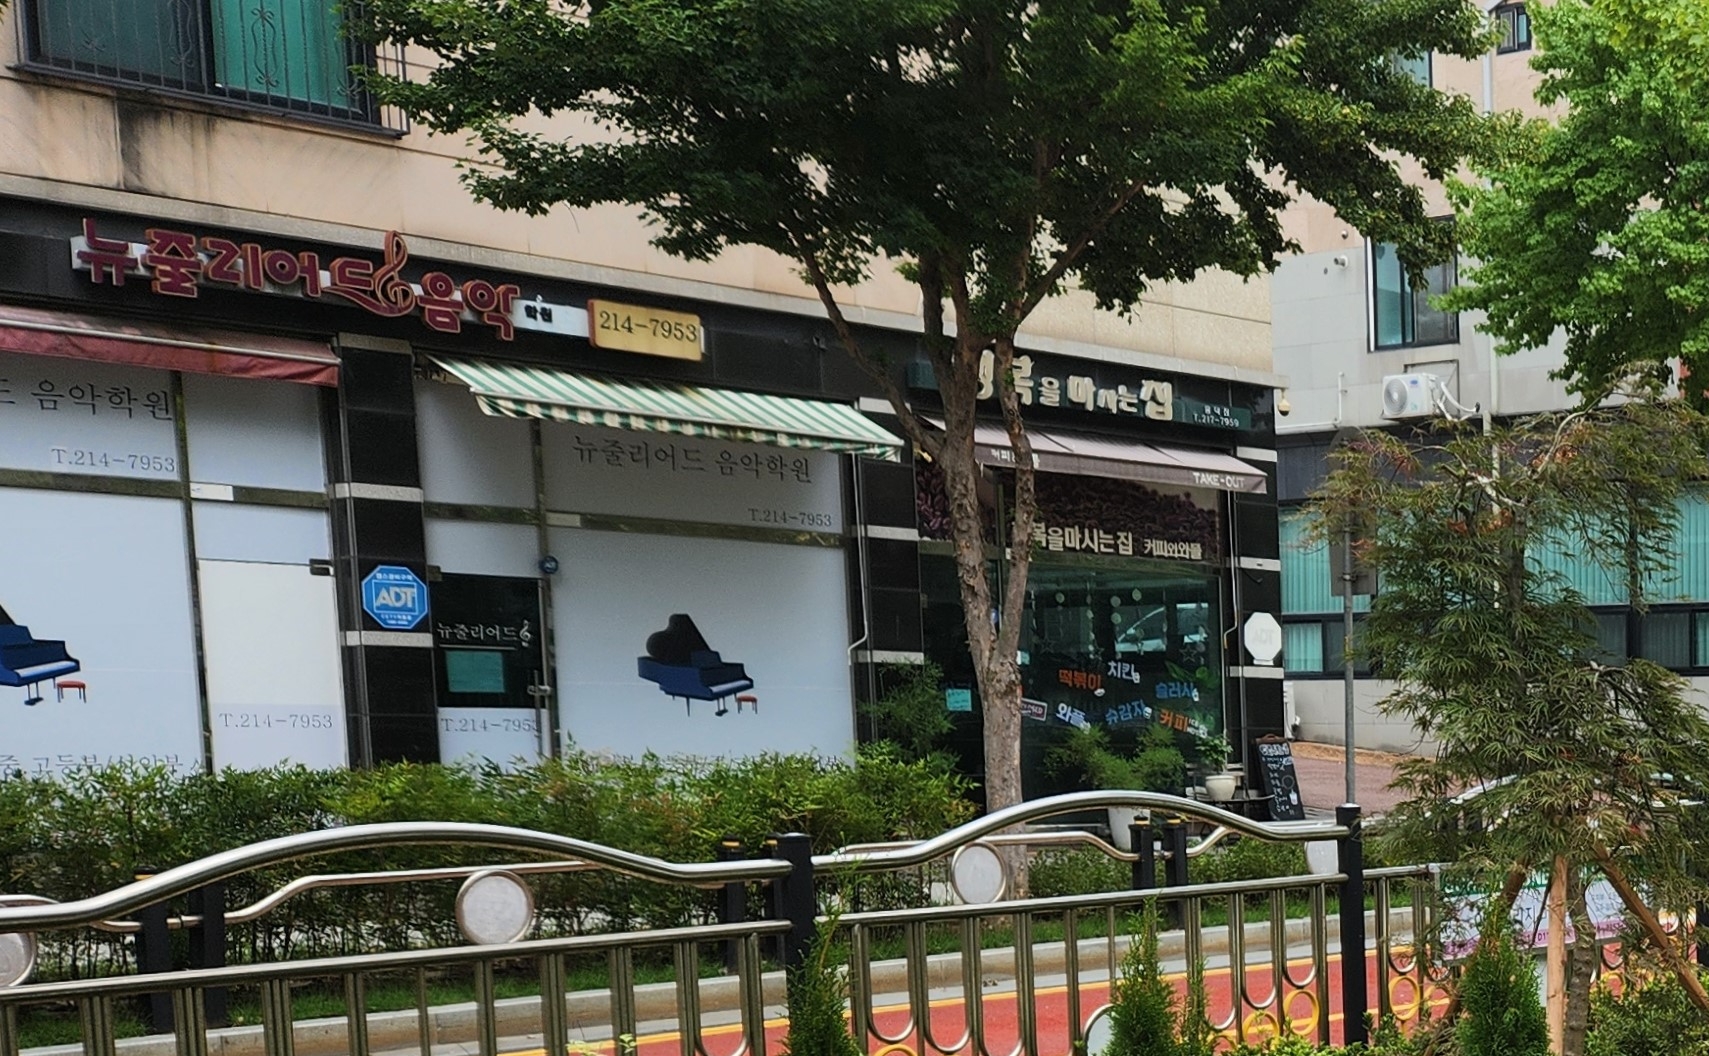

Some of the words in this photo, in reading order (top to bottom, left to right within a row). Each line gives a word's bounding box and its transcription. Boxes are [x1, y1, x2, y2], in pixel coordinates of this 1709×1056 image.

[77, 218, 400, 317] 뉴줄리어드
[417, 271, 521, 341] 음악
[600, 311, 698, 343] 214-7953
[31, 379, 173, 421] 음악학원
[51, 448, 175, 473] T.214-7953
[573, 435, 706, 473] 뉴줄리어드
[715, 449, 812, 483] 음악학원
[1192, 471, 1246, 489] TAKE-OUT
[747, 507, 832, 527] T.214-7953
[376, 586, 415, 608] ADT
[437, 622, 518, 641] 뉴줄리어드
[1059, 669, 1101, 690] 떡볶이
[1108, 660, 1136, 680] 치킨
[219, 713, 333, 729] T.214-7953
[1160, 708, 1189, 733] 커피
